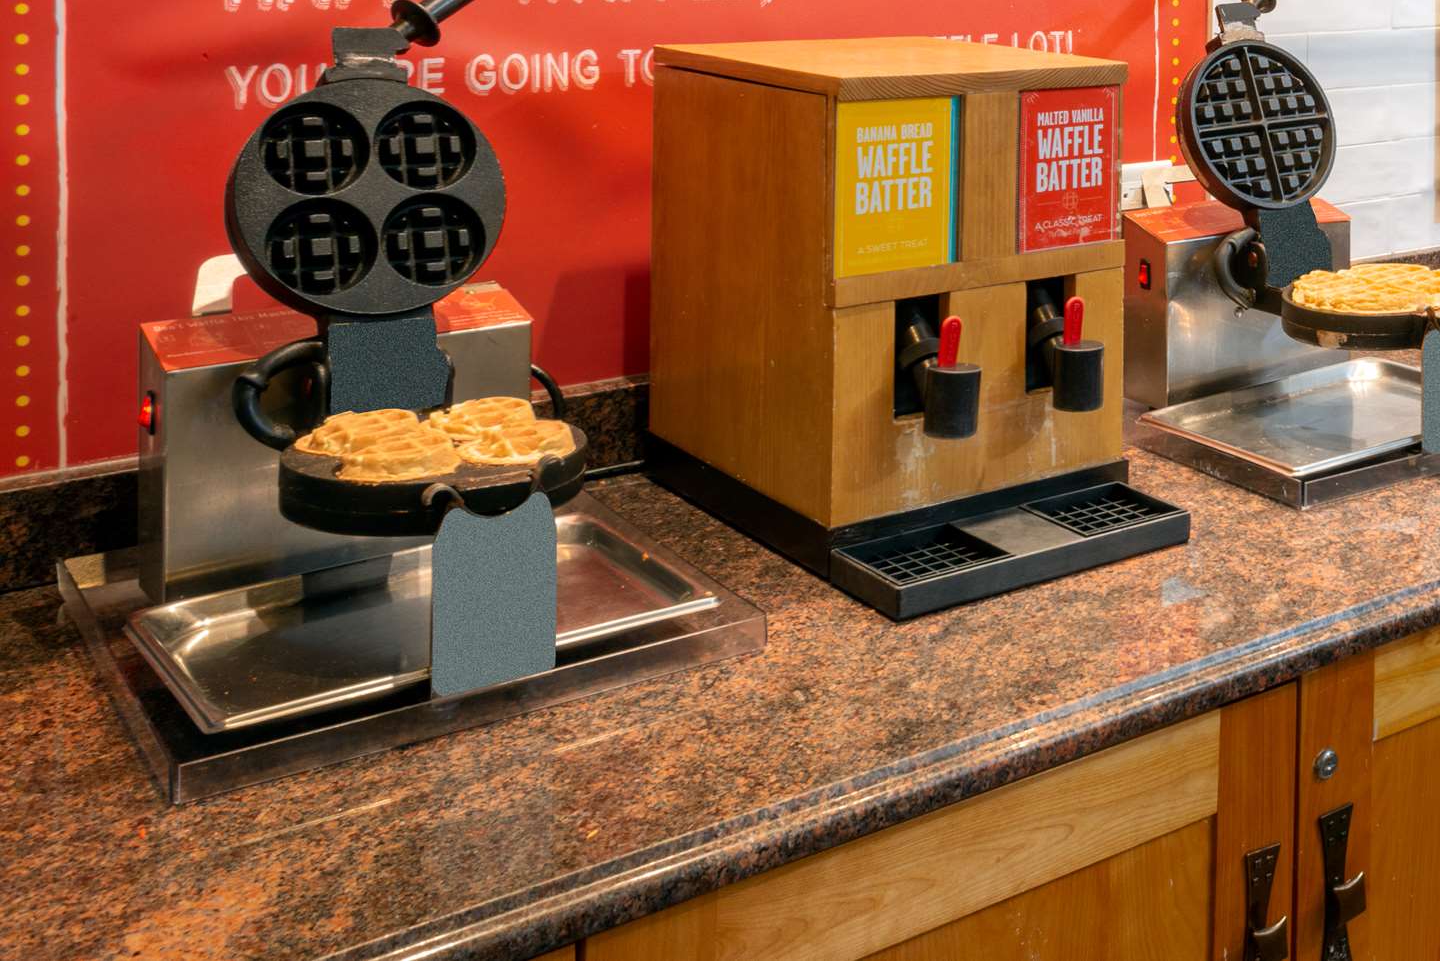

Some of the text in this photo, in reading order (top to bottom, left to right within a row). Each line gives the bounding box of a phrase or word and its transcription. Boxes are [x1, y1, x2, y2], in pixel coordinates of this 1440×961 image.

[465, 48, 600, 97] GOING
[856, 122, 933, 143] BANANA BREAD
[1037, 108, 1104, 127] MALTED VANILLA
[856, 140, 934, 179] WAFFLE
[1037, 124, 1104, 160] WAFFLE
[1036, 157, 1103, 193] BATTER
[855, 176, 932, 215] BATTER
